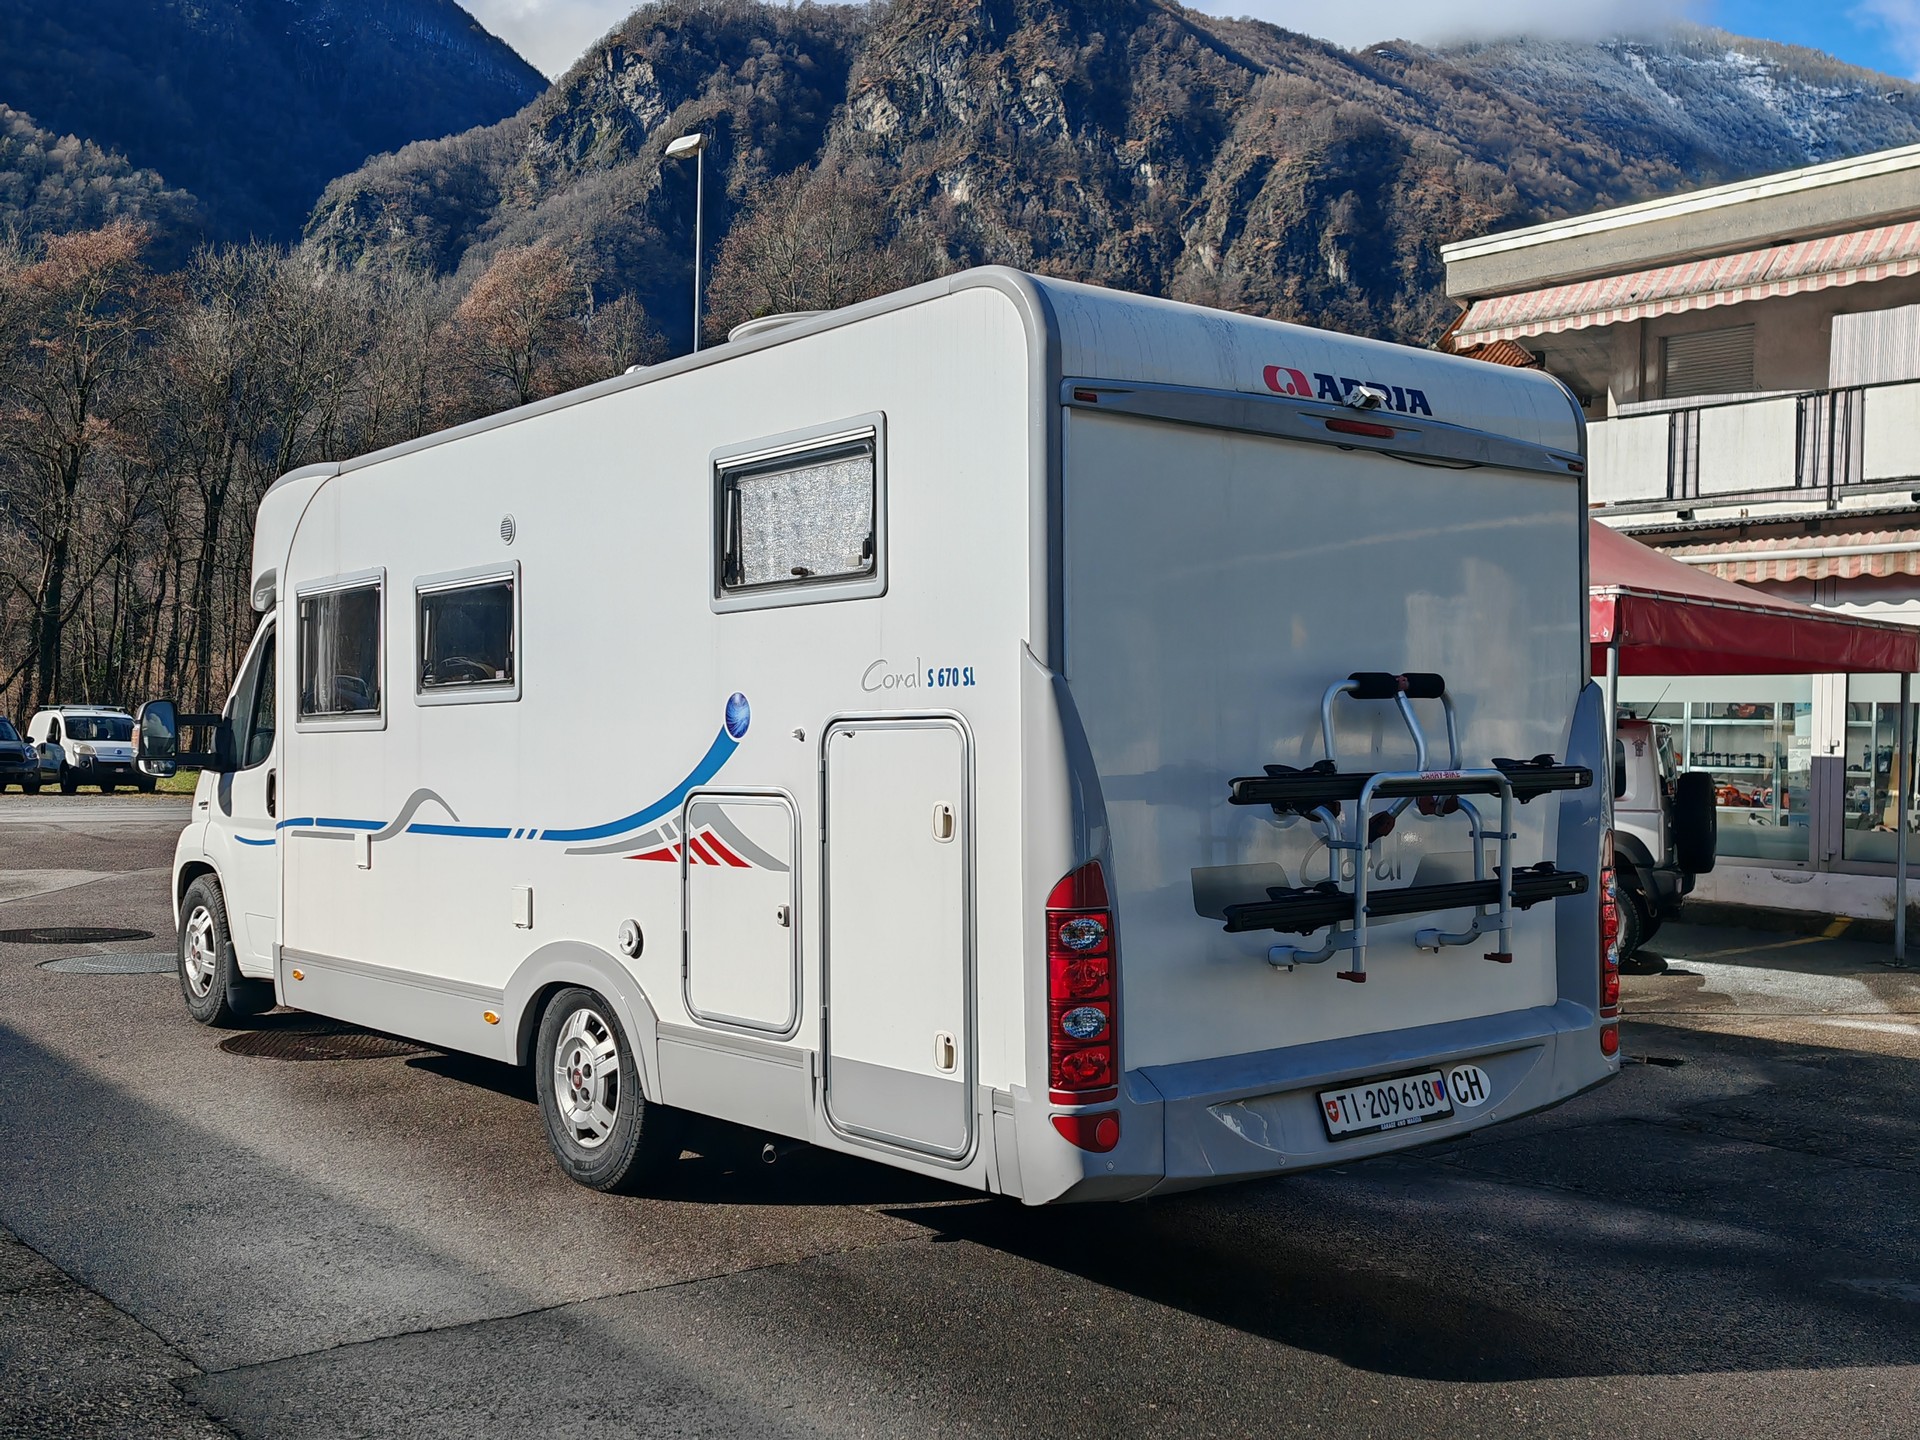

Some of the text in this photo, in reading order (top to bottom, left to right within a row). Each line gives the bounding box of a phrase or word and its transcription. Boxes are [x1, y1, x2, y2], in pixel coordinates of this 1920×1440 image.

[861, 656, 976, 692] Coral S 670 SL
[1300, 831, 1402, 888] Coal
[1452, 1068, 1485, 1104] CH
